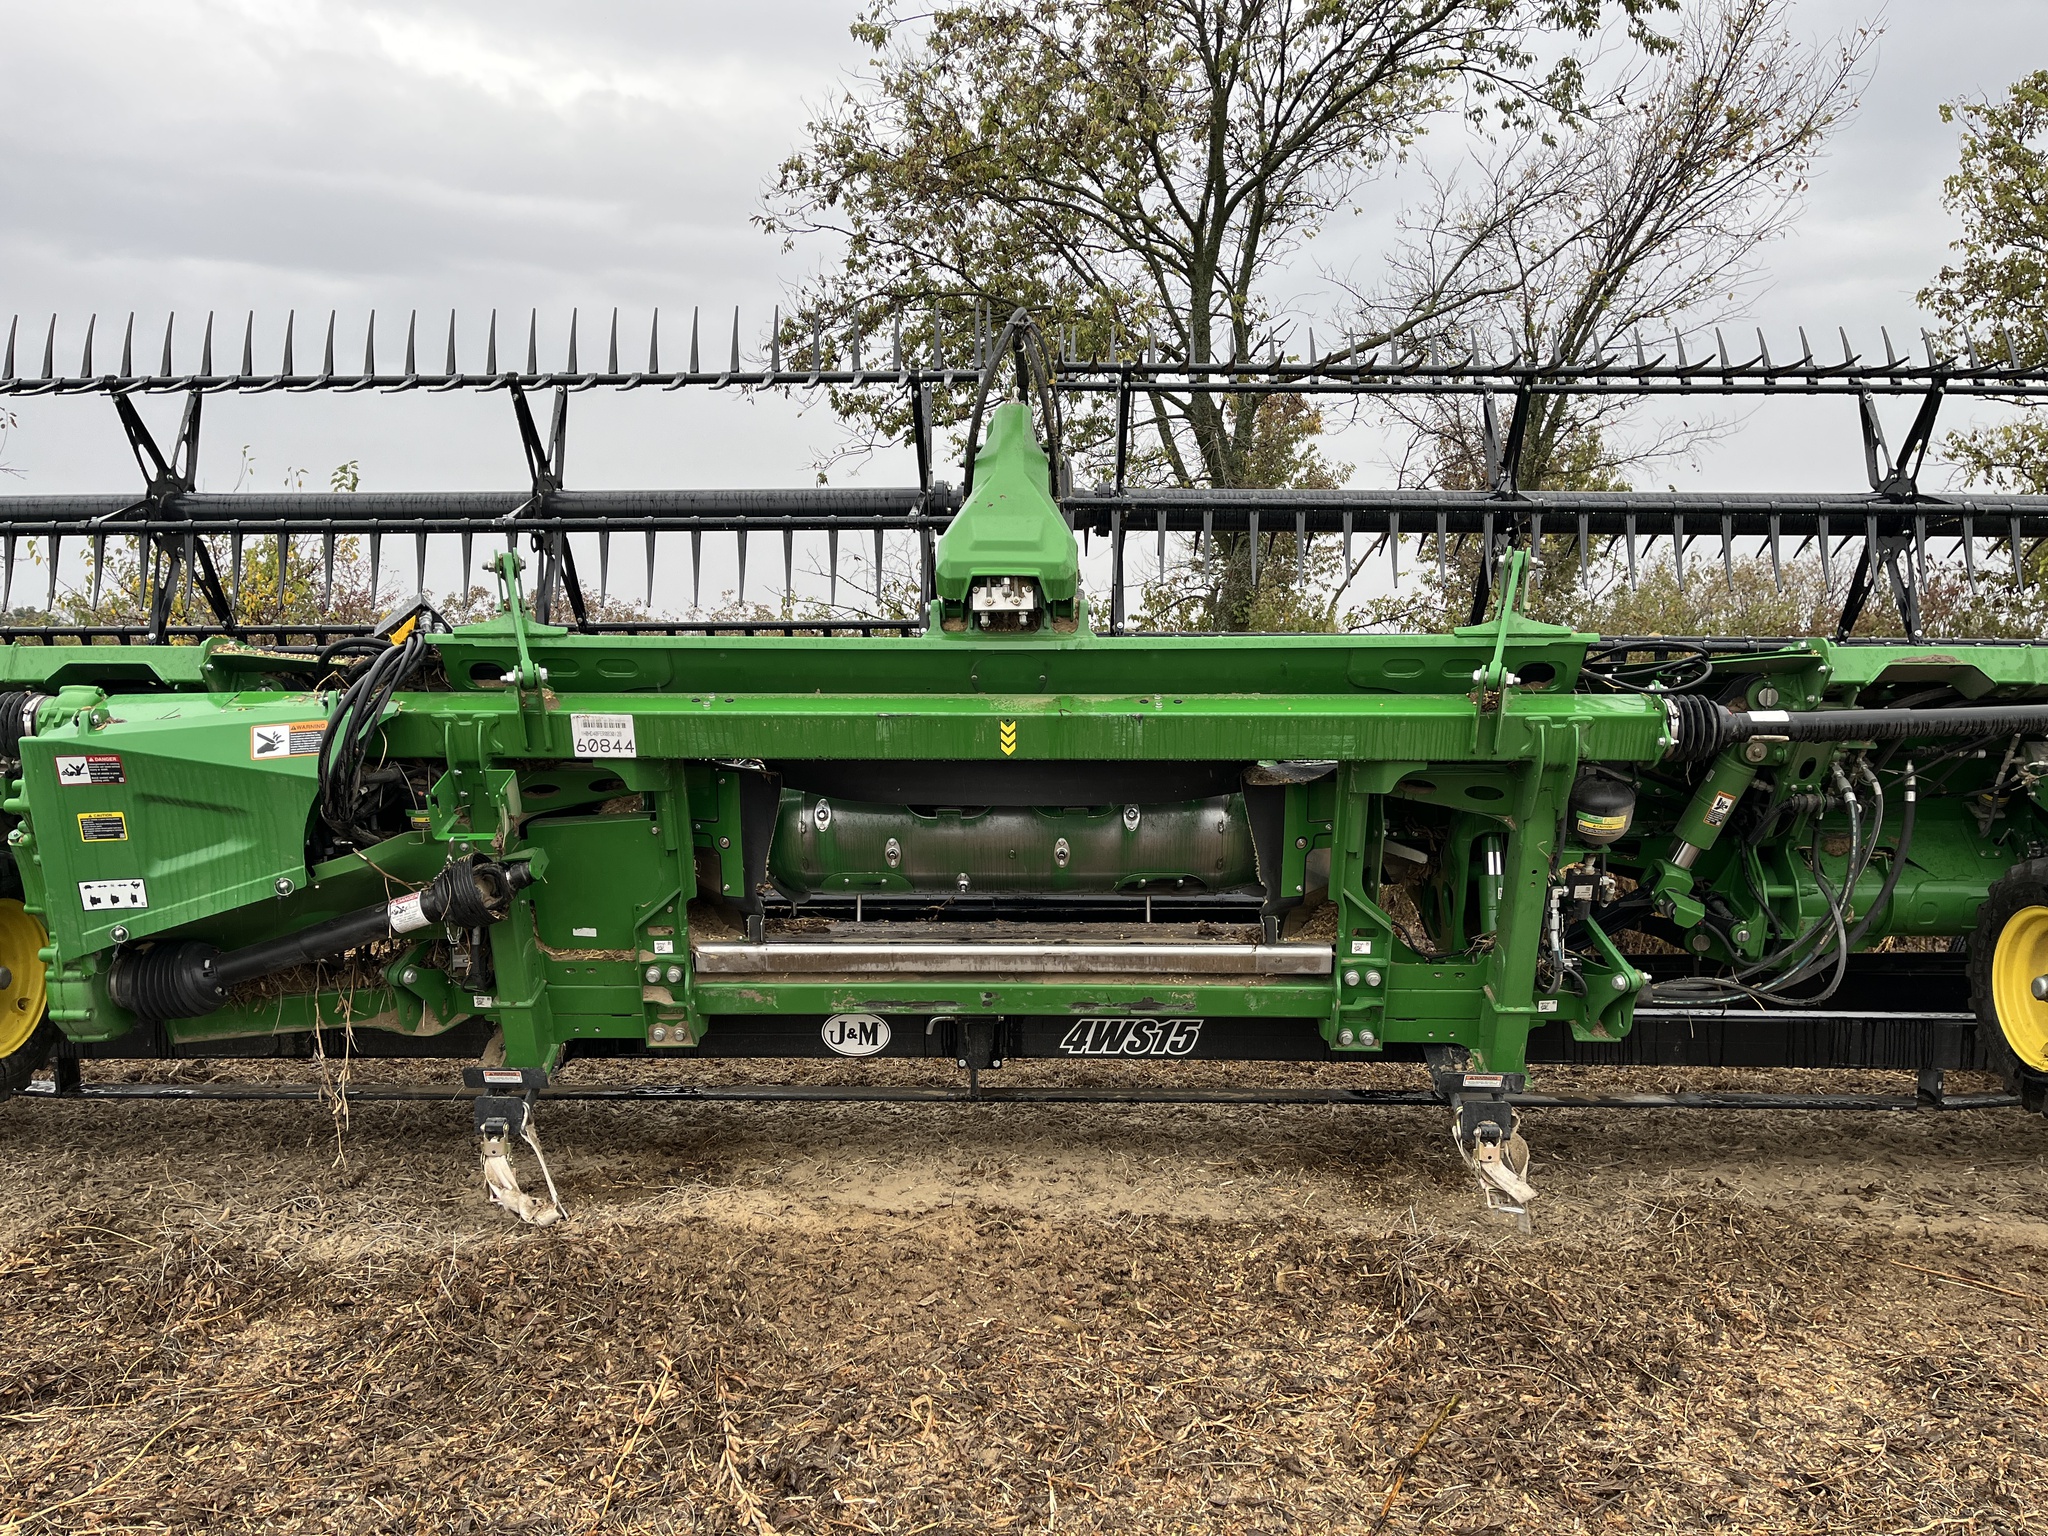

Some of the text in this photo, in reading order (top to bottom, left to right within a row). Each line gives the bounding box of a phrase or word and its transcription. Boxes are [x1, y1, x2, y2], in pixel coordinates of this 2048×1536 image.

[576, 738, 635, 754] 60844
[829, 1021, 880, 1046] J&M
[1060, 1018, 1204, 1055] 4WS15
